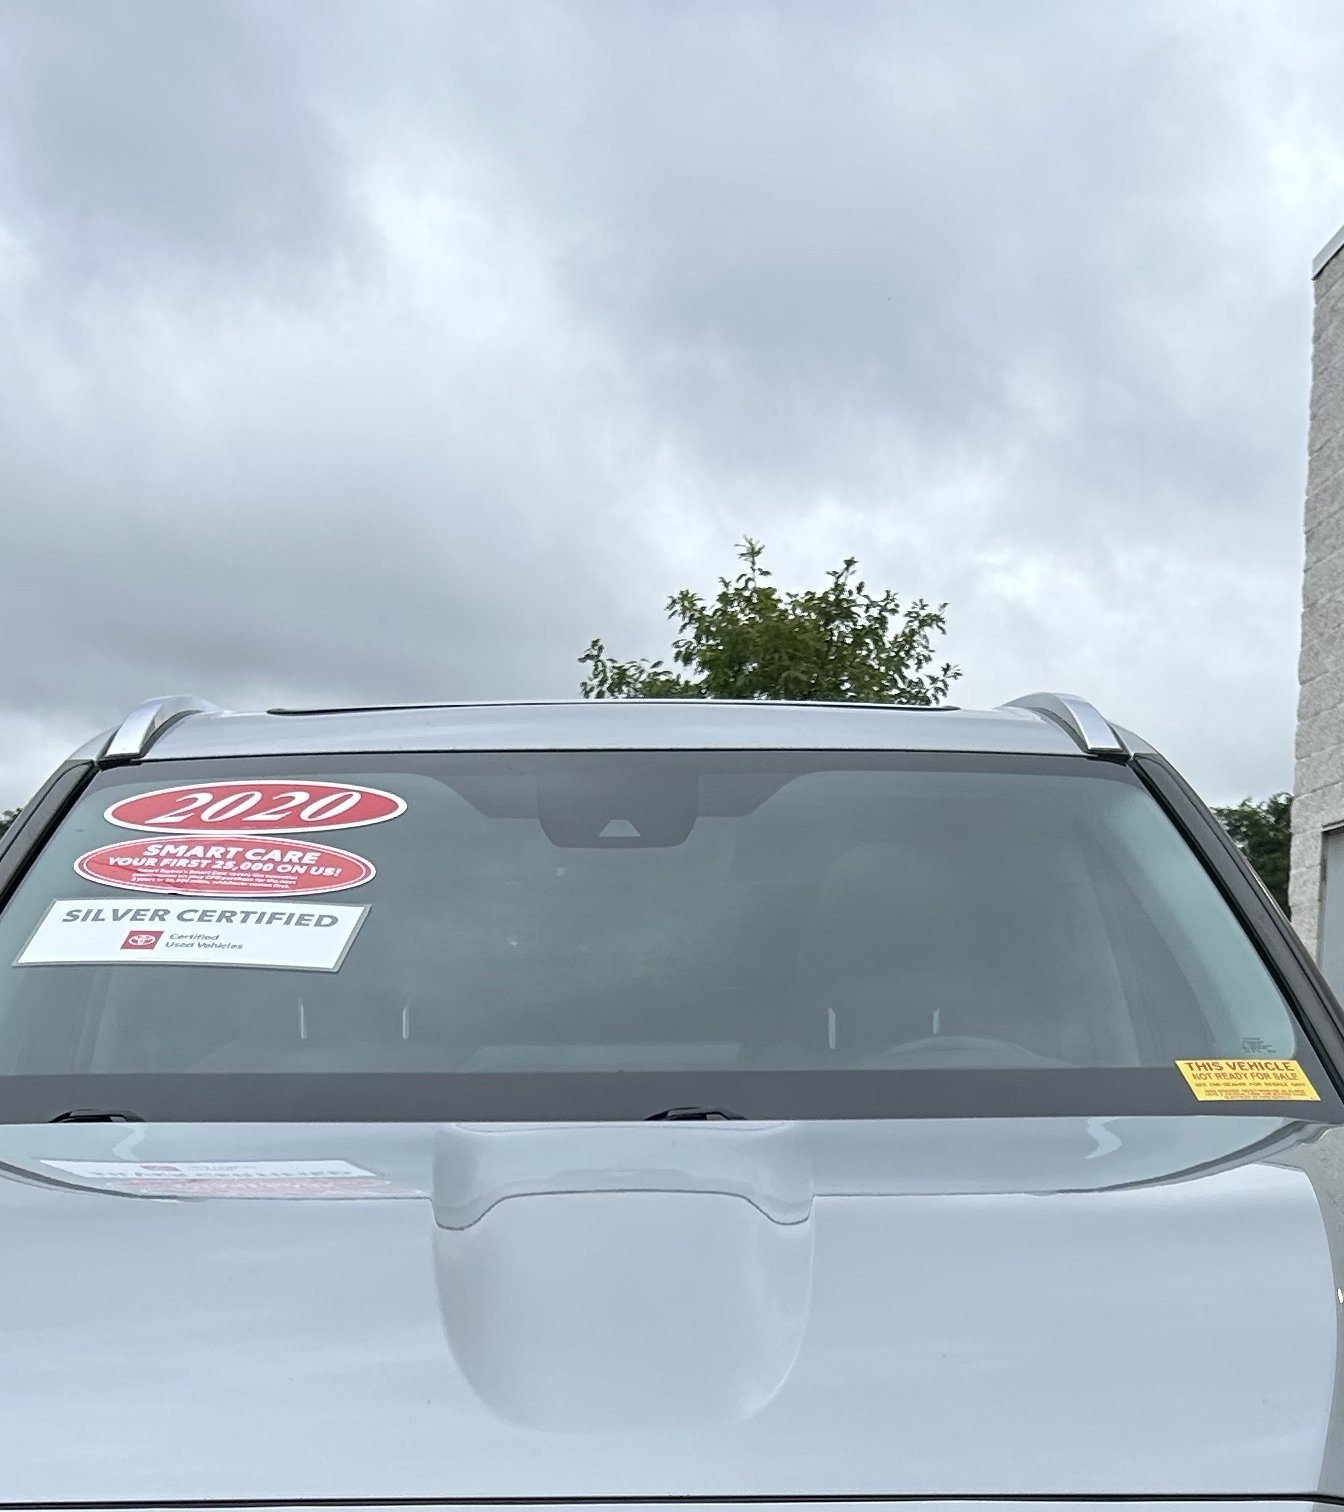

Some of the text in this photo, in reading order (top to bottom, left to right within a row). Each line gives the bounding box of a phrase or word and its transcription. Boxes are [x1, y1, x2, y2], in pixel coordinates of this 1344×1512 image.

[145, 790, 362, 824] 2020
[143, 844, 321, 865] SMART CARE
[108, 856, 158, 867] YOUR
[160, 858, 213, 869] FIRST
[212, 860, 274, 872] 25,000
[276, 864, 309, 875] ON
[310, 866, 343, 878] US!
[61, 908, 340, 928] SILVER CERTIFIED
[169, 933, 221, 941] Certified
[1184, 1061, 1296, 1072] THIS VEHICLE
[1192, 1073, 1299, 1081] NOT READY FOR SALE
